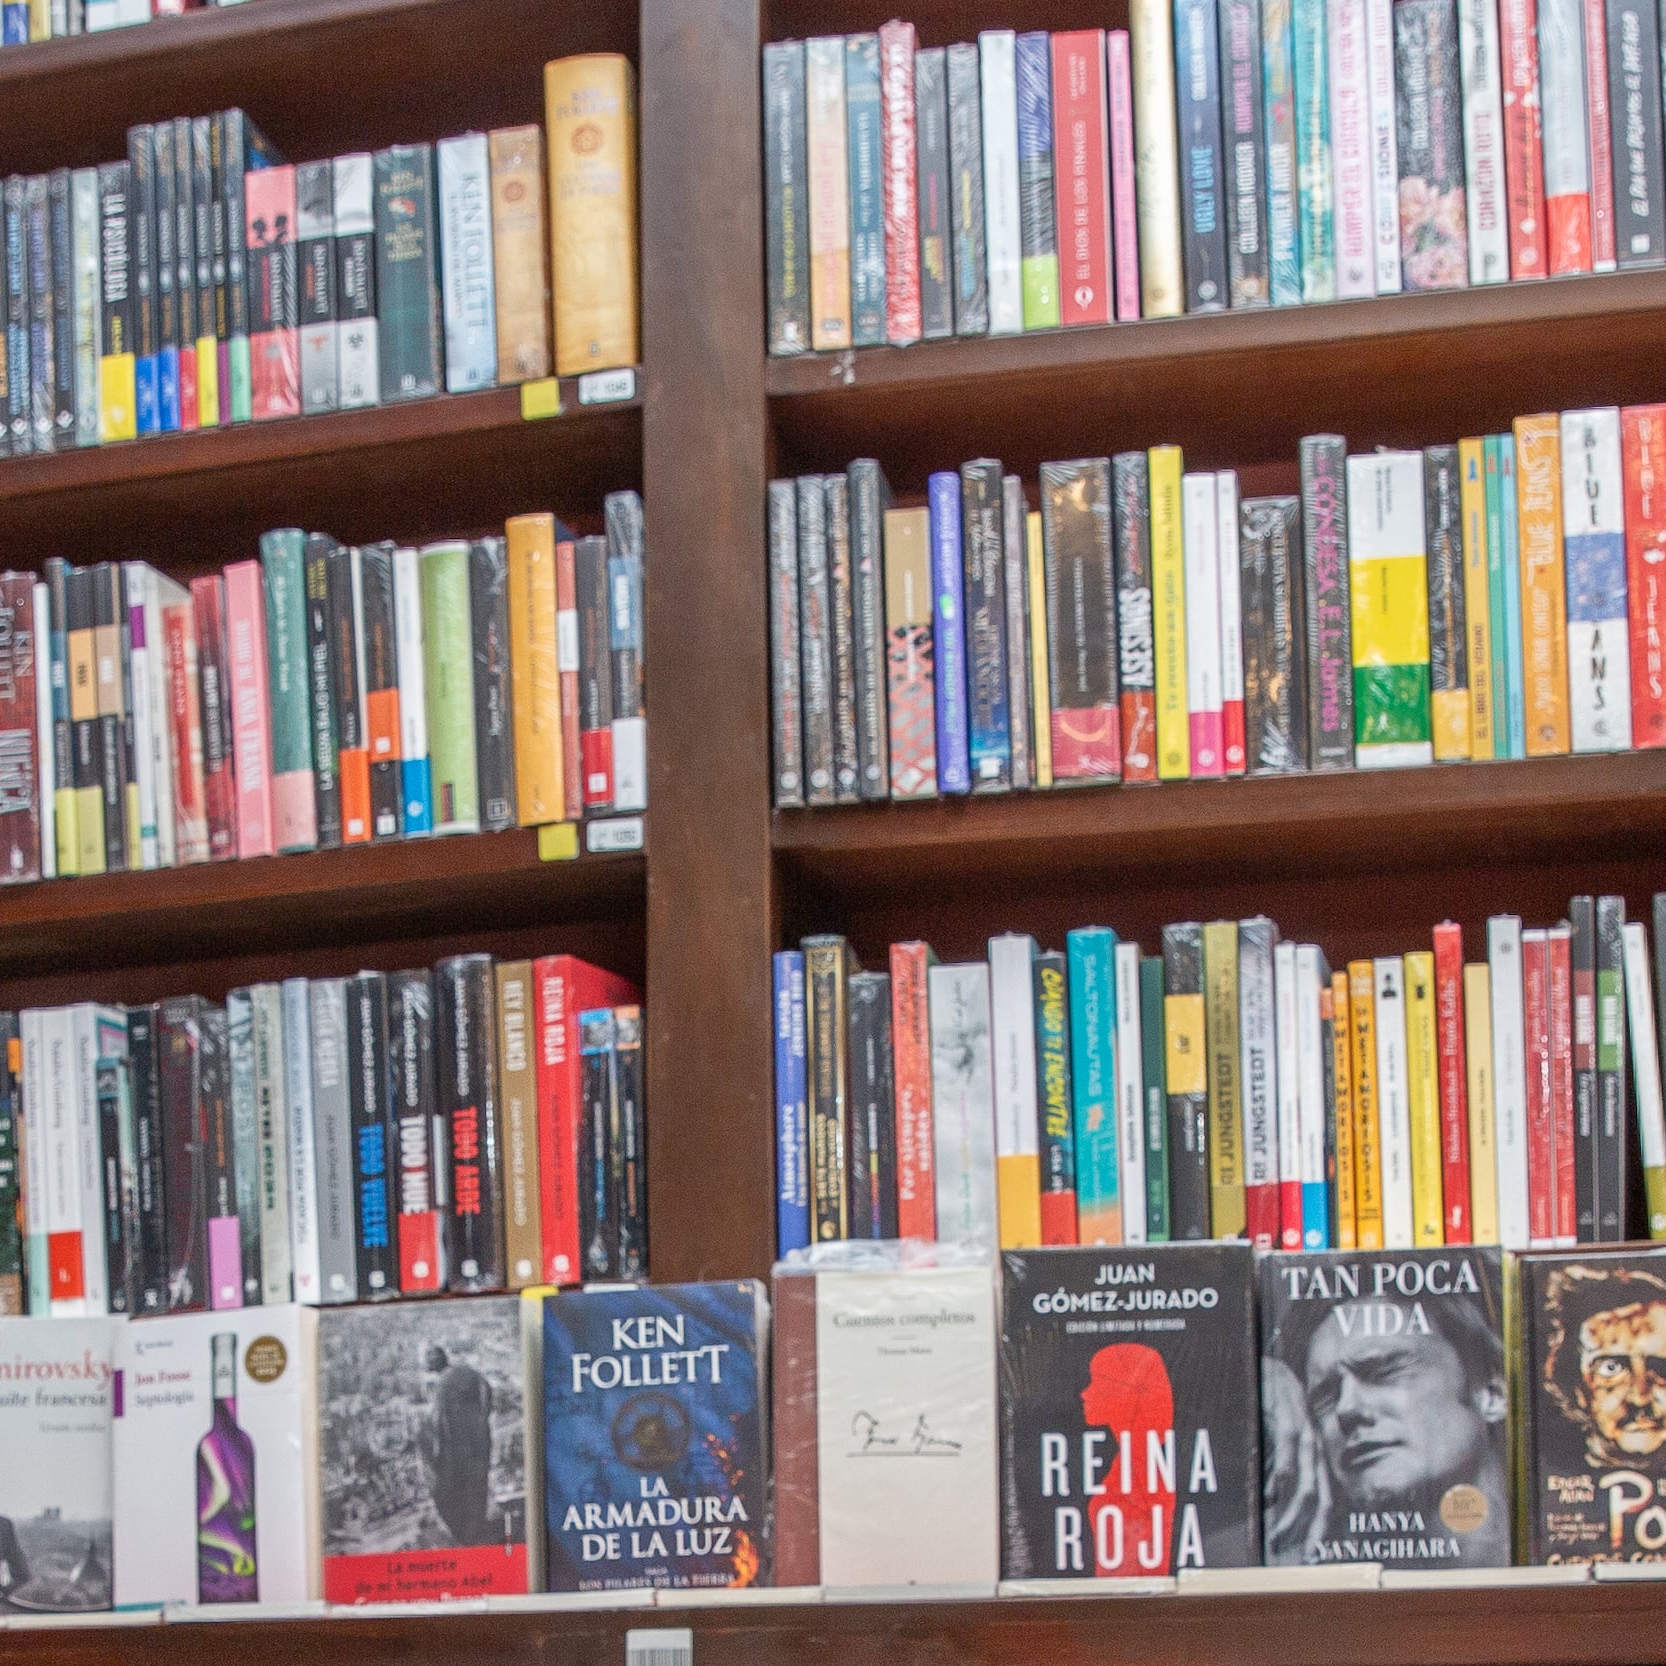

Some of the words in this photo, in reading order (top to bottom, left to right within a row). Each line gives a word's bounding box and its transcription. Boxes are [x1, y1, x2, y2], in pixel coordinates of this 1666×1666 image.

[15, 631, 33, 676] KEN
[1120, 586, 1152, 686] ASESINOS
[238, 687, 259, 724] ANA
[1319, 657, 1340, 732] James
[240, 731, 261, 791] FRANK
[503, 980, 524, 1007] REY
[543, 976, 566, 1021] REINA
[504, 1012, 527, 1071] BLANCO
[544, 1024, 566, 1065] ROJA
[1215, 1053, 1232, 1158] JUNGSTEDT
[1248, 1047, 1267, 1155] JUNGSTEDT
[400, 1115, 425, 1168] TODO
[453, 1106, 478, 1158] TODO
[455, 1164, 480, 1216] ARDE
[1093, 1263, 1155, 1285] JUAN
[1281, 1264, 1362, 1300] TAN
[1372, 1260, 1481, 1295] POCA
[1032, 1286, 1219, 1315] GÓMEZ-JURADO
[1333, 1302, 1432, 1338] VIDA
[611, 1315, 685, 1351] KEN
[571, 1345, 730, 1393] FOLLETT
[34, 1387, 108, 1408] francesa
[1040, 1427, 1218, 1497] REINA
[640, 1476, 670, 1498] LA
[562, 1495, 748, 1530] ARMADURA
[1349, 1511, 1426, 1534] HANYA
[582, 1533, 621, 1562] DE
[632, 1531, 668, 1558] LA
[677, 1526, 734, 1556] LUZ
[1054, 1502, 1206, 1572] ROJA
[1314, 1535, 1462, 1562] YANAGIHARA
[387, 1559, 404, 1575] La
[408, 1559, 457, 1573] muerte
[396, 1576, 457, 1591] hermano
[461, 1572, 494, 1588] Abel
